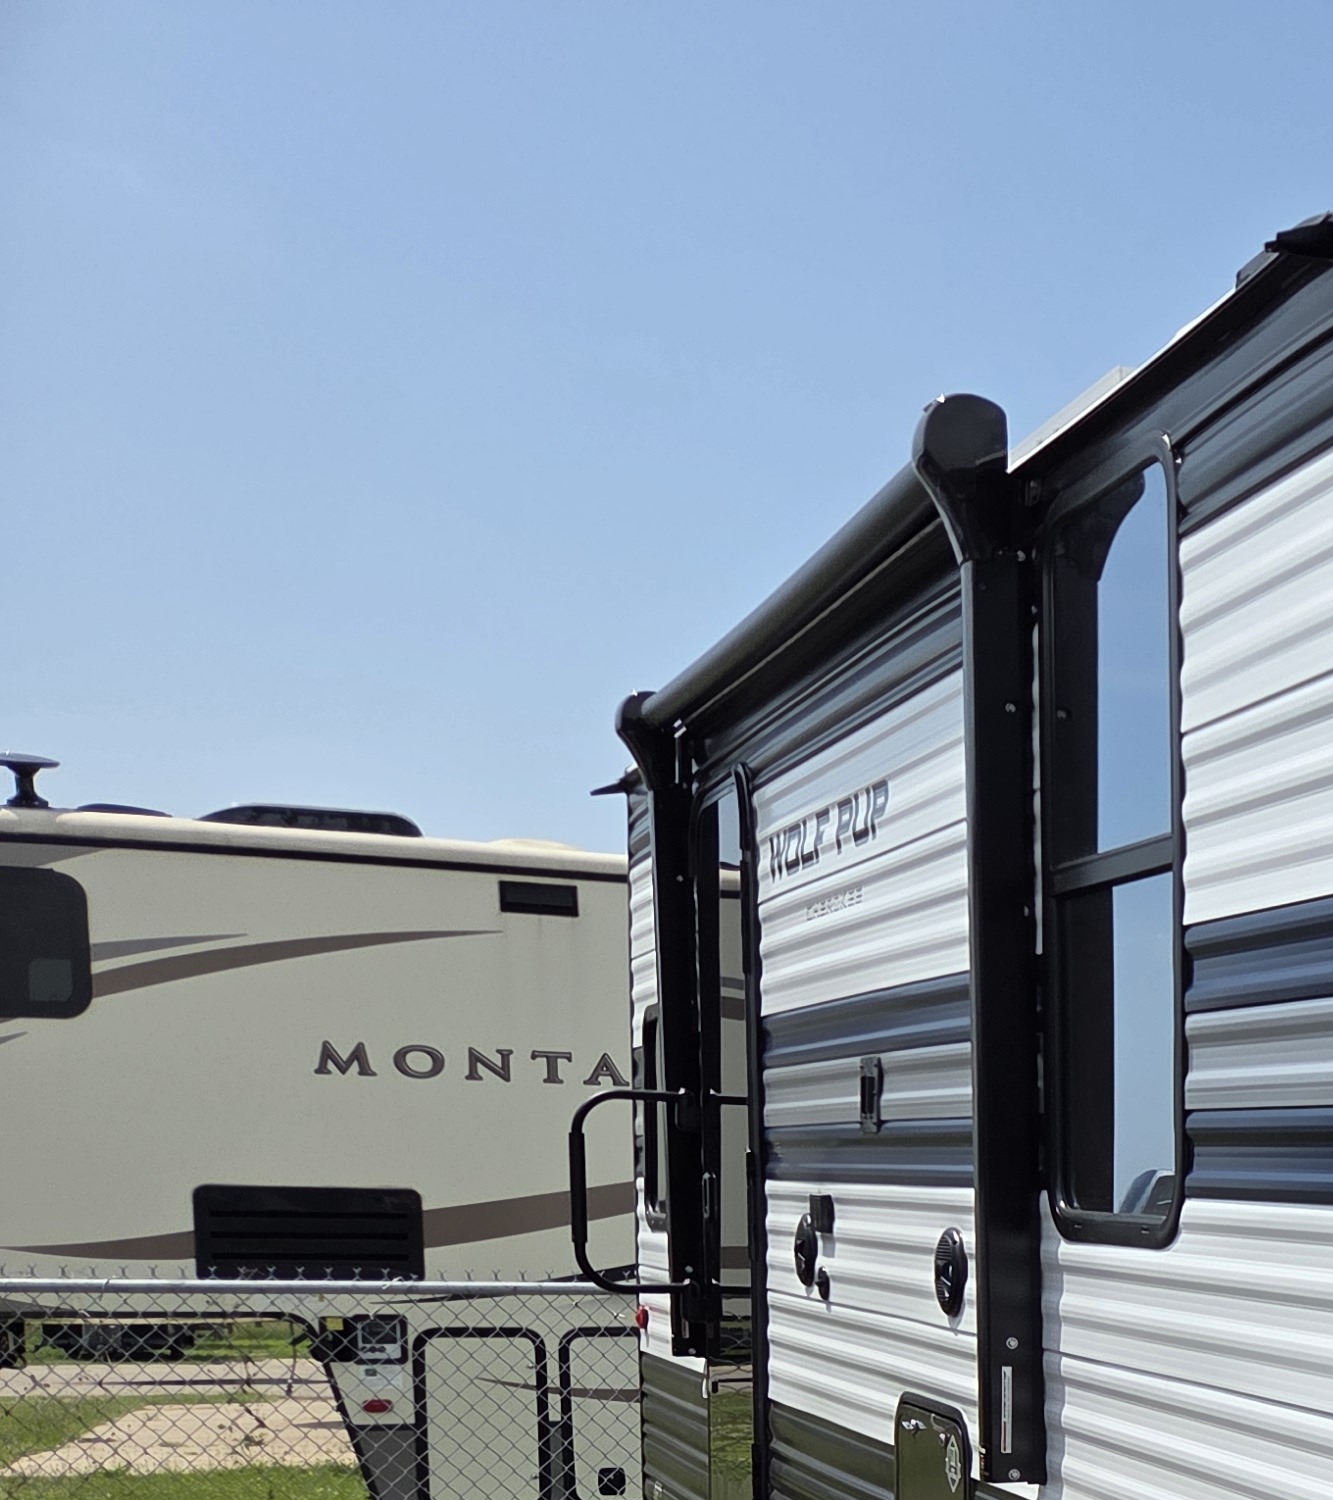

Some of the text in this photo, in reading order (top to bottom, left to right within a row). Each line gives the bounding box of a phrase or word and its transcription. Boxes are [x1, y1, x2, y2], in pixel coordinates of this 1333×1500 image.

[769, 779, 889, 884] WOLF PUP
[313, 1039, 631, 1087] MONTA
